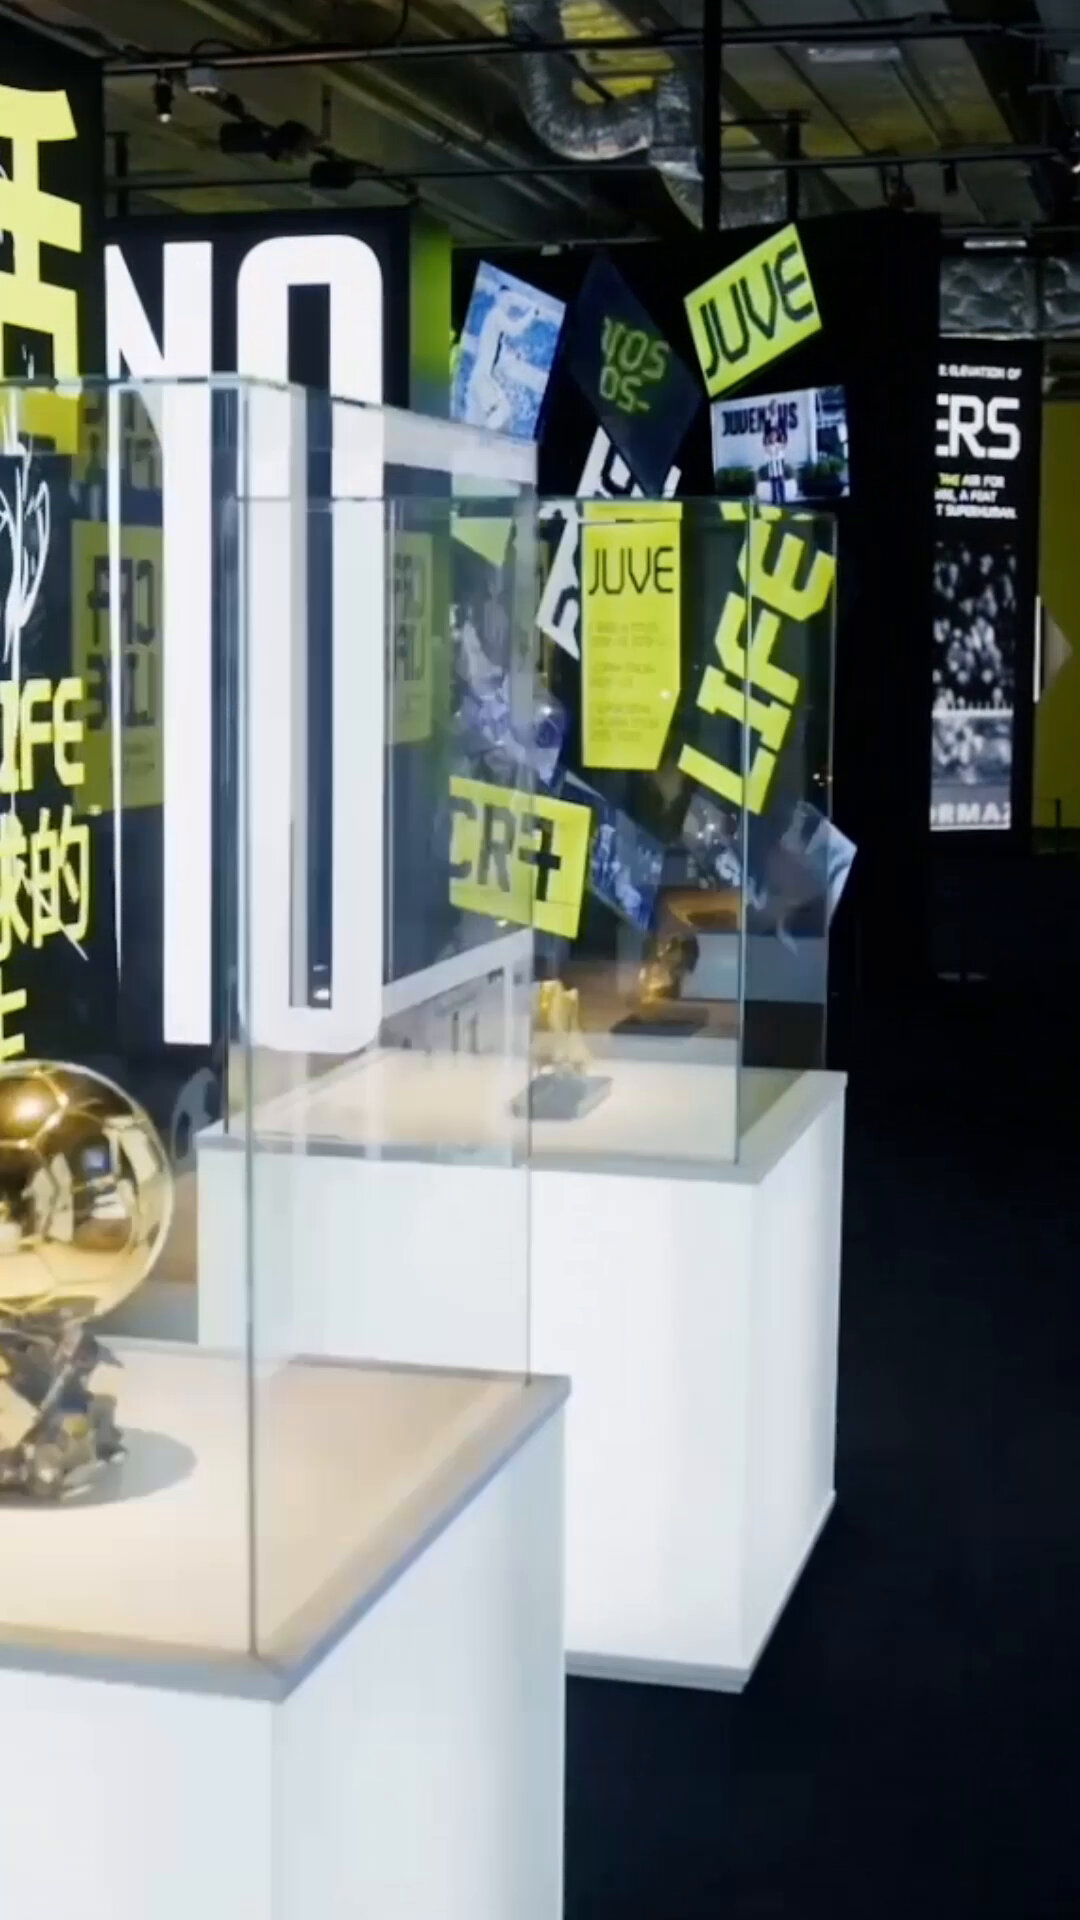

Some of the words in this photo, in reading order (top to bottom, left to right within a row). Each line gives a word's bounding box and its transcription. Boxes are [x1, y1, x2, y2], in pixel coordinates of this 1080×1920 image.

[698, 241, 814, 379] JUVE
[721, 401, 799, 437] JUVENUS
[588, 546, 674, 596] JUVE
[677, 515, 837, 815] LIFE
